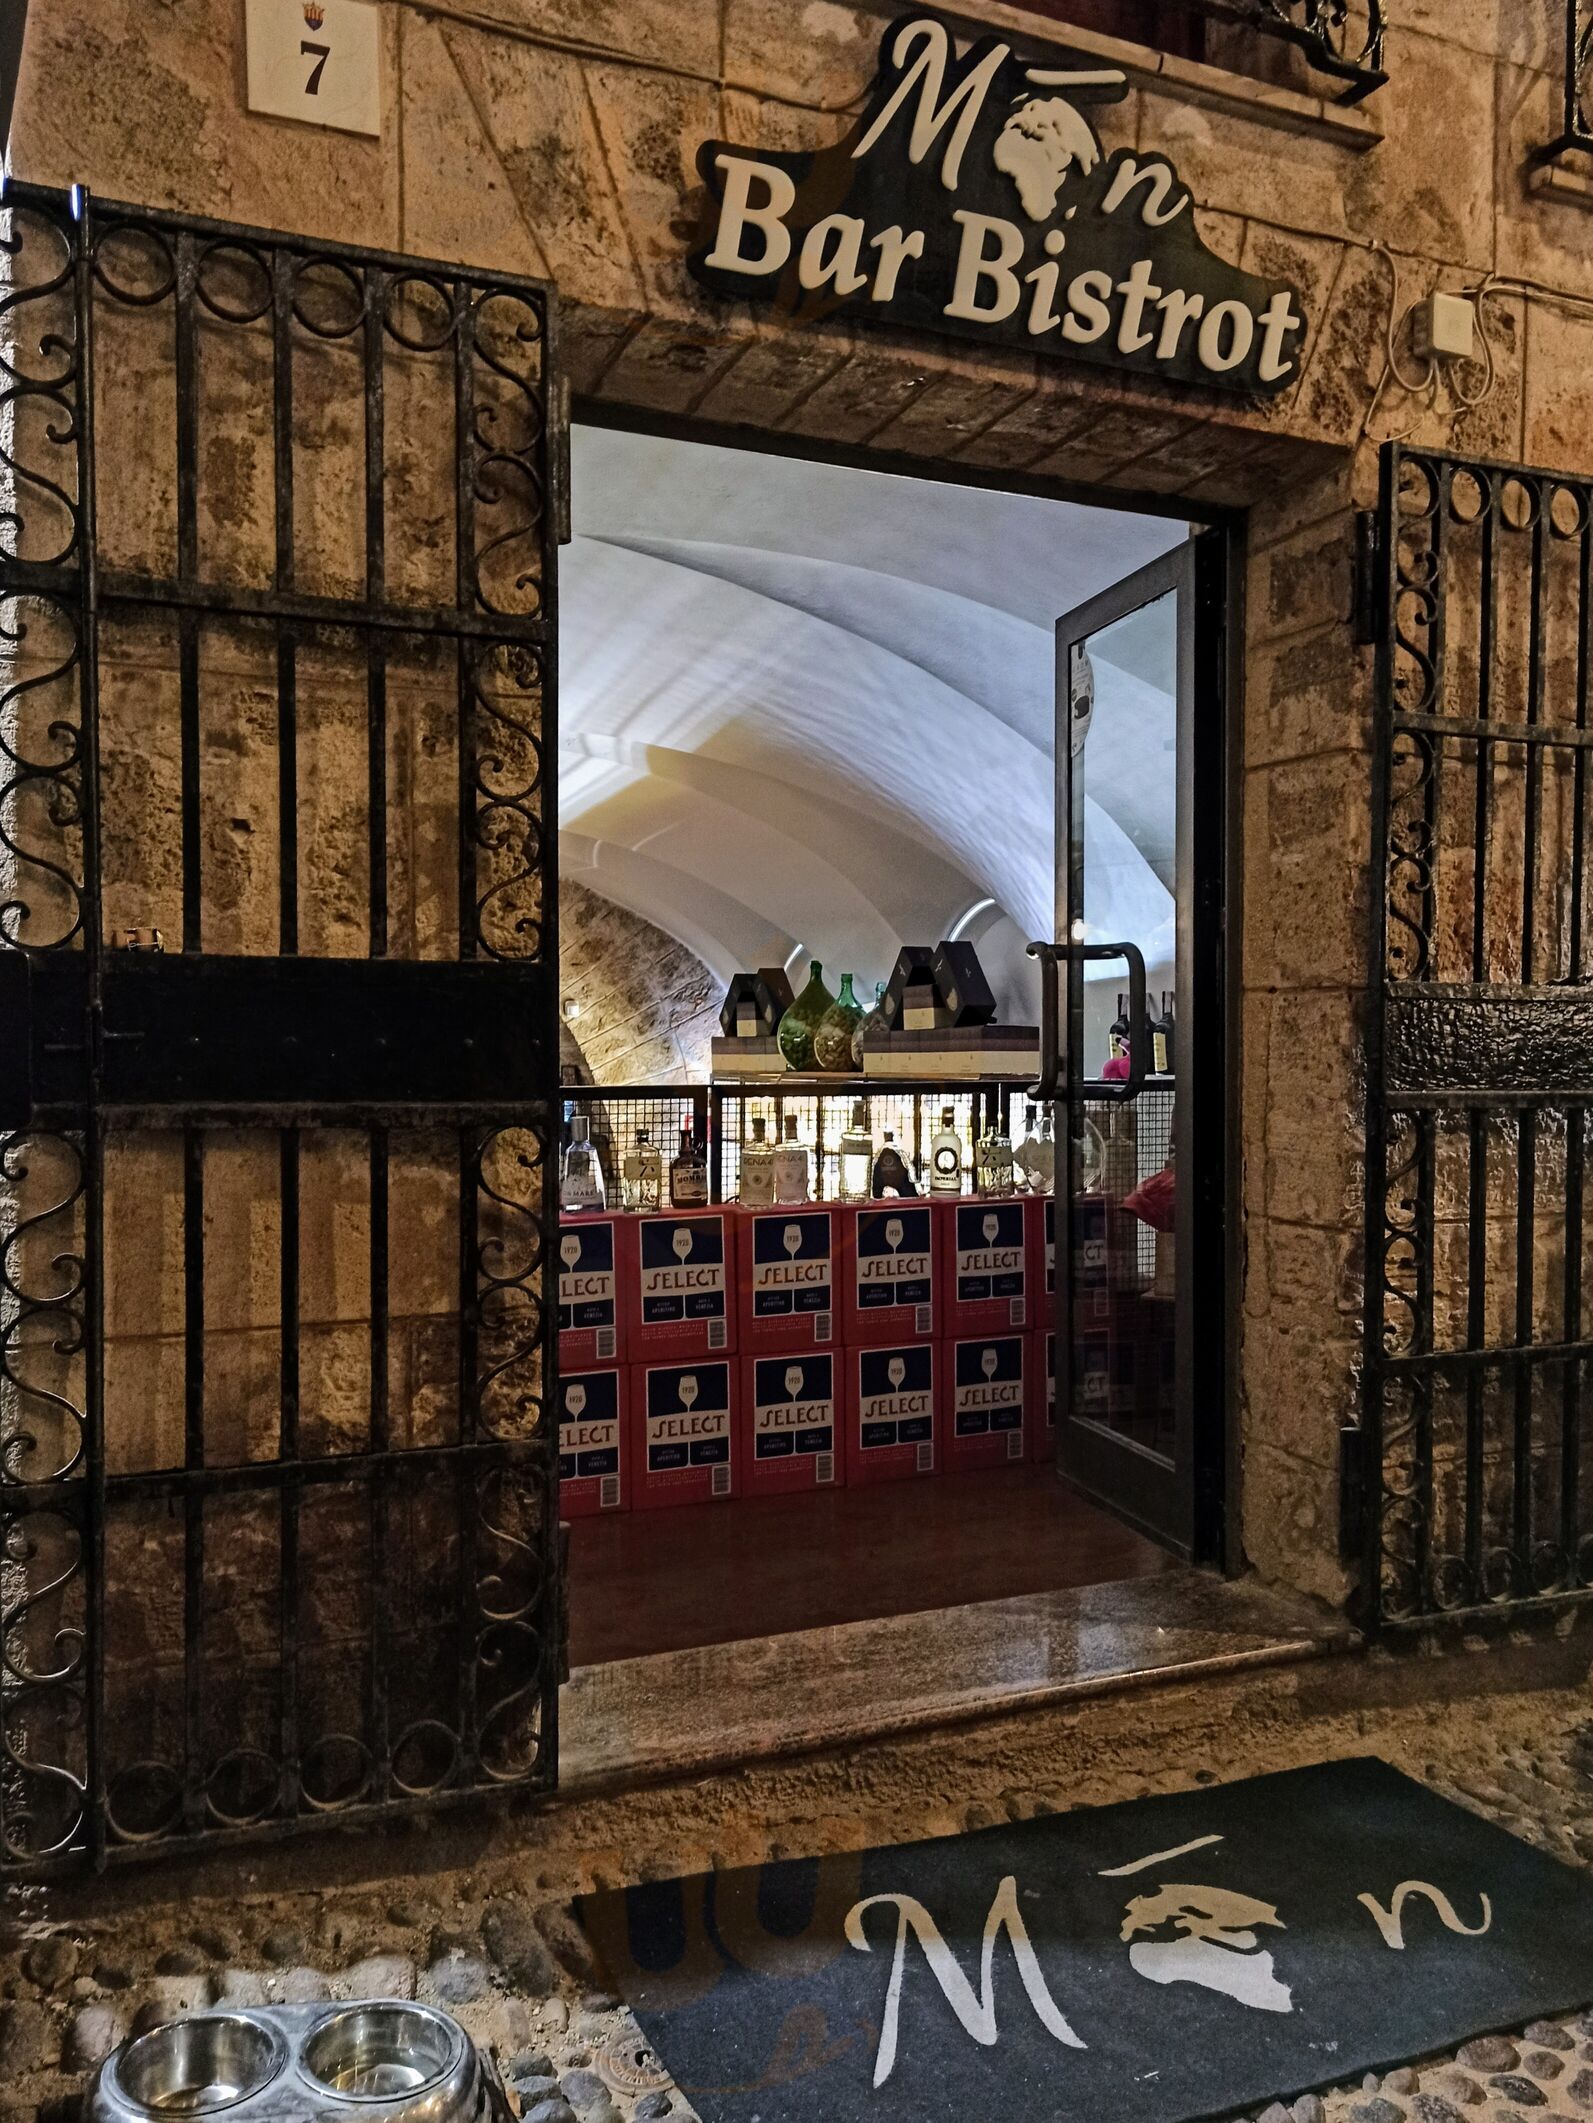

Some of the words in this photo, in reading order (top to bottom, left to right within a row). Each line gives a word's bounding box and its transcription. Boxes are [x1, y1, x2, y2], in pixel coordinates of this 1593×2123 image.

[301, 40, 331, 95] 7
[704, 153, 924, 302] Bar
[942, 209, 1300, 383] Bistrot
[862, 1257, 928, 1278] SELECT
[961, 1251, 1020, 1271] SELECT
[646, 1268, 720, 1291] SELECT
[758, 1264, 827, 1285] SELECT
[561, 1276, 610, 1297] LECT
[865, 1395, 929, 1418] SELECT
[959, 1385, 1019, 1406] SELECT
[652, 1415, 725, 1439] SELECT
[760, 1405, 829, 1428] SELECT
